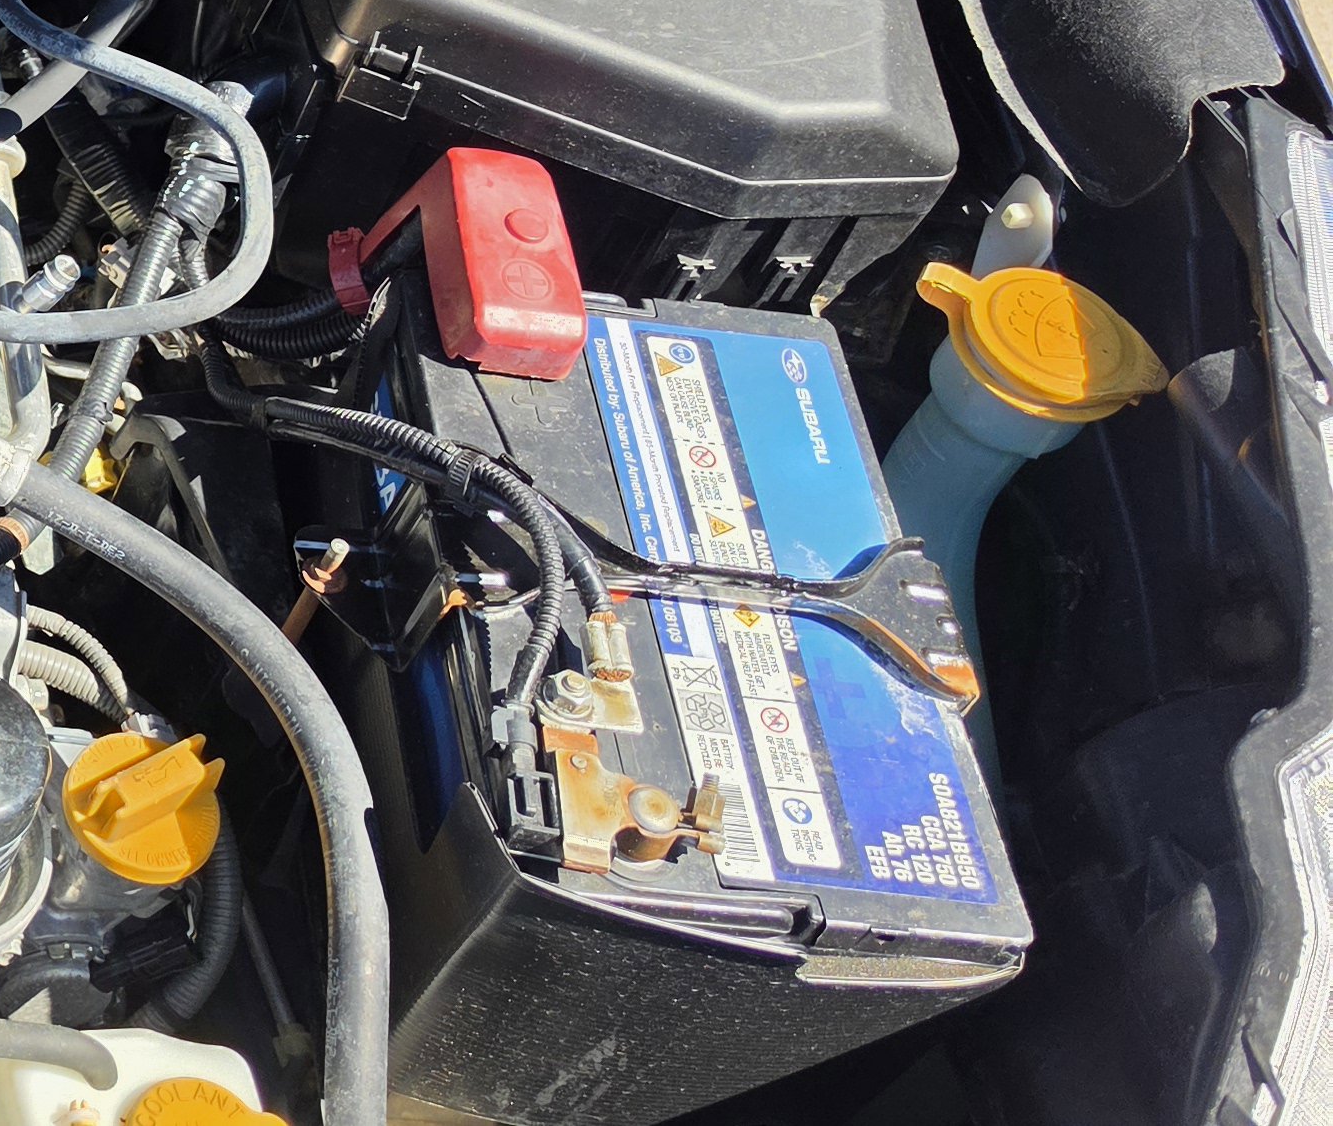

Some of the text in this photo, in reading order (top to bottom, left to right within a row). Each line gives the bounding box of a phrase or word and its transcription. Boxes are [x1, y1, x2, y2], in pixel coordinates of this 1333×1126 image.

[593, 337, 617, 391] Distributed
[627, 375, 637, 388] Free
[674, 377, 683, 389] CAN
[604, 394, 622, 409] by:
[631, 391, 649, 433] Replacement
[677, 390, 688, 408] CAUSE
[682, 378, 706, 438] EXPLOSIVE GASES
[613, 412, 632, 449] Subaru
[794, 387, 830, 464] SUBARU
[623, 452, 636, 461] of
[625, 464, 648, 510] America,
[691, 474, 704, 502] SMOKING
[700, 475, 712, 499] FLAMES
[708, 476, 721, 500] SPARKS
[716, 472, 726, 482] NO
[638, 513, 654, 533] Inc.
[661, 506, 680, 551] Replacement
[689, 533, 700, 544] DO
[661, 608, 682, 642] 08103
[732, 630, 747, 659] MEDICAL
[741, 661, 752, 678] HELP
[743, 631, 754, 647] WITH
[755, 676, 765, 688] GET
[753, 632, 771, 676] IMMEDIATELY
[762, 633, 779, 673] FLUSH EYES
[671, 667, 681, 679] Pb
[696, 734, 711, 768] RECYCLED
[709, 738, 722, 767] MUST BE
[720, 739, 734, 769] BATTERY
[765, 736, 774, 744] OF
[775, 737, 792, 774] THE REACH
[785, 738, 804, 782] KEEP OUT OF
[811, 831, 822, 849] READ
[882, 831, 913, 881] Ah 76
[901, 824, 935, 884] RC 120
[919, 815, 958, 887] CCA 750
[865, 845, 891, 879] EFB
[135, 1081, 246, 1126] COOLANT
